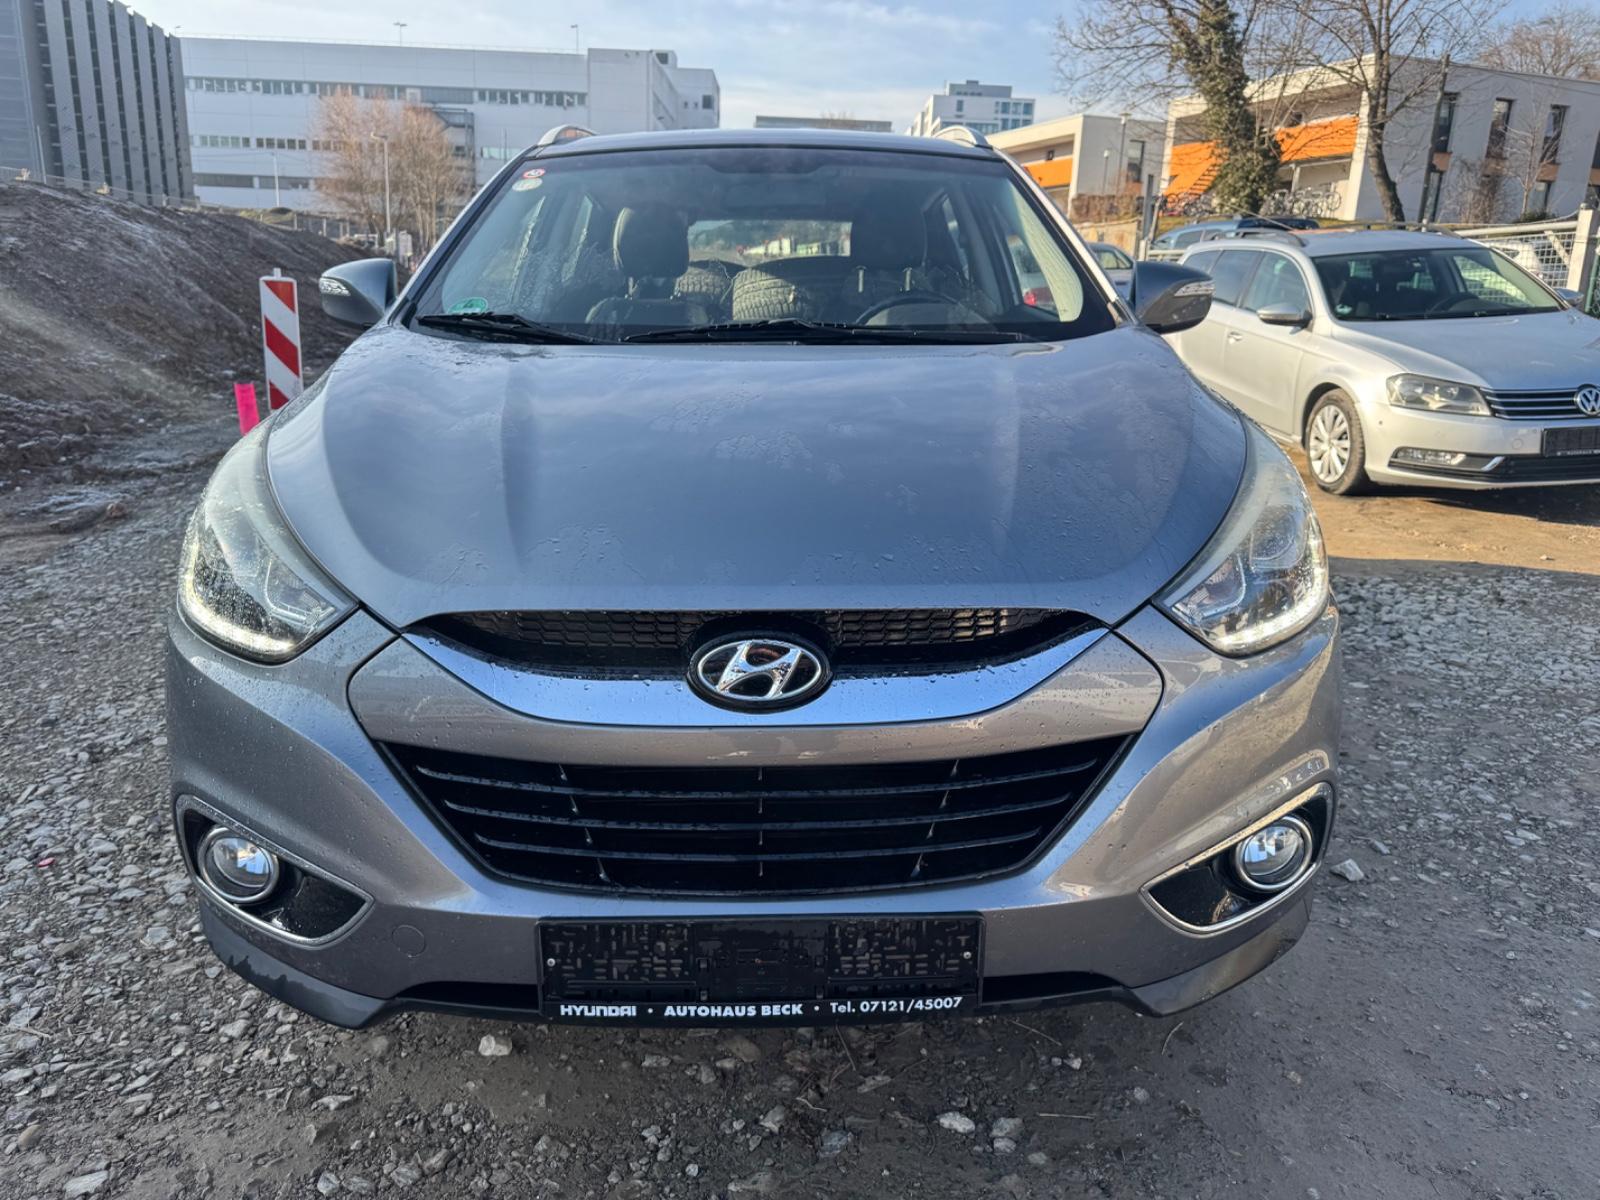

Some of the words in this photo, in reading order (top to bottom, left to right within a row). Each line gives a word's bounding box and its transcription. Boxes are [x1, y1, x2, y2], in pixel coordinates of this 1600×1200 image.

[559, 1004, 638, 1017] HYUNDAI
[663, 1004, 758, 1017] AUTOHAUS
[760, 1003, 804, 1016] BECK
[829, 1001, 856, 1014] Tel.
[859, 996, 963, 1014] 07121/45007
